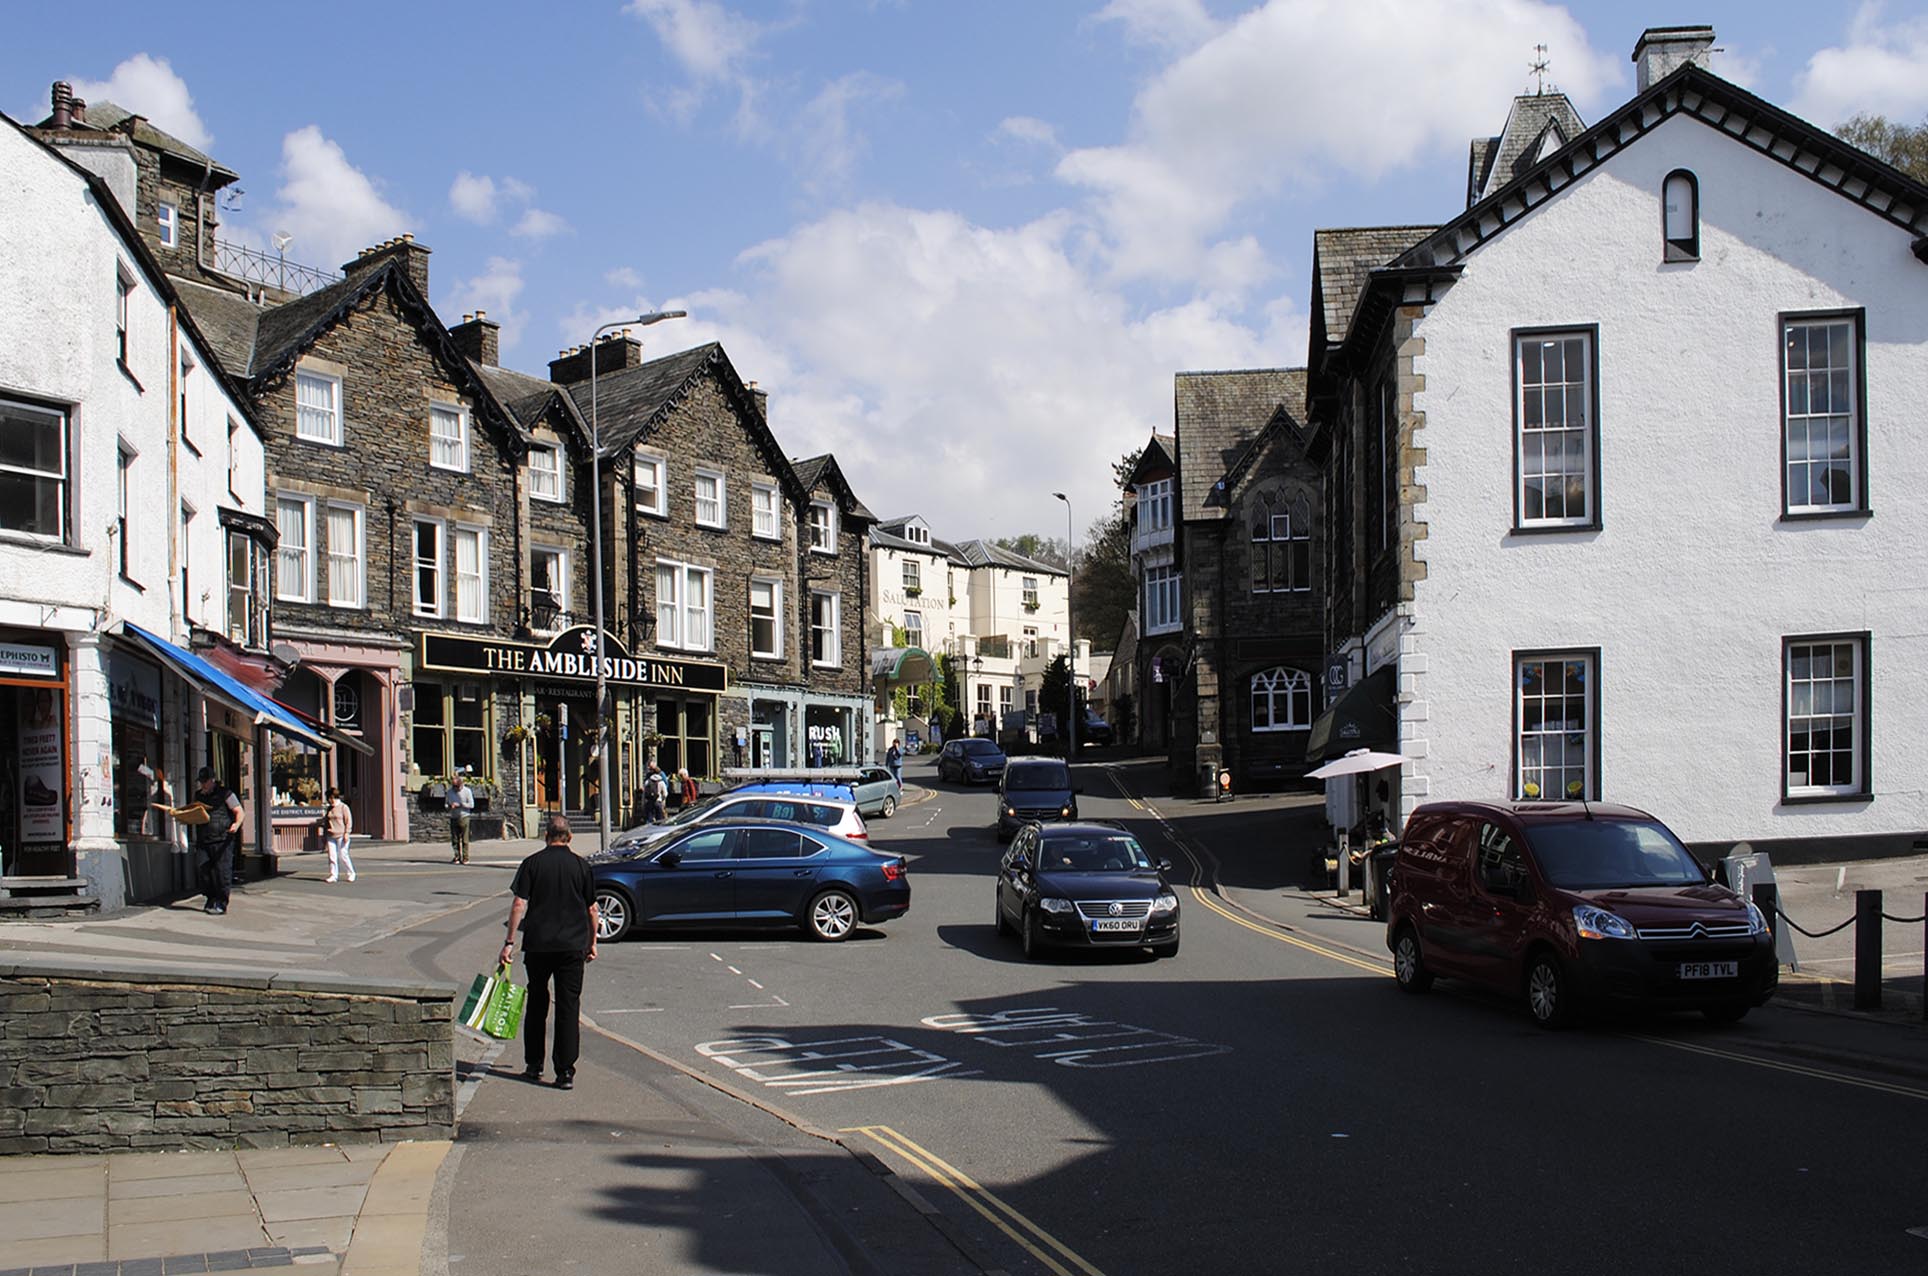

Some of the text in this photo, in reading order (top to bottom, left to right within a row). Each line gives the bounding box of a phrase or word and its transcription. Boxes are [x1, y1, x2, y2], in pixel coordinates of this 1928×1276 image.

[883, 590, 945, 611] SALUTATION
[483, 647, 685, 685] THE AMBLESIDE INN
[808, 725, 840, 740] RUSH
[1098, 921, 1138, 930] VK60 ORU
[1685, 963, 1733, 977] PF18 TVL
[920, 1007, 1234, 1069] CLEAR
[694, 1035, 985, 1096] KEEP
